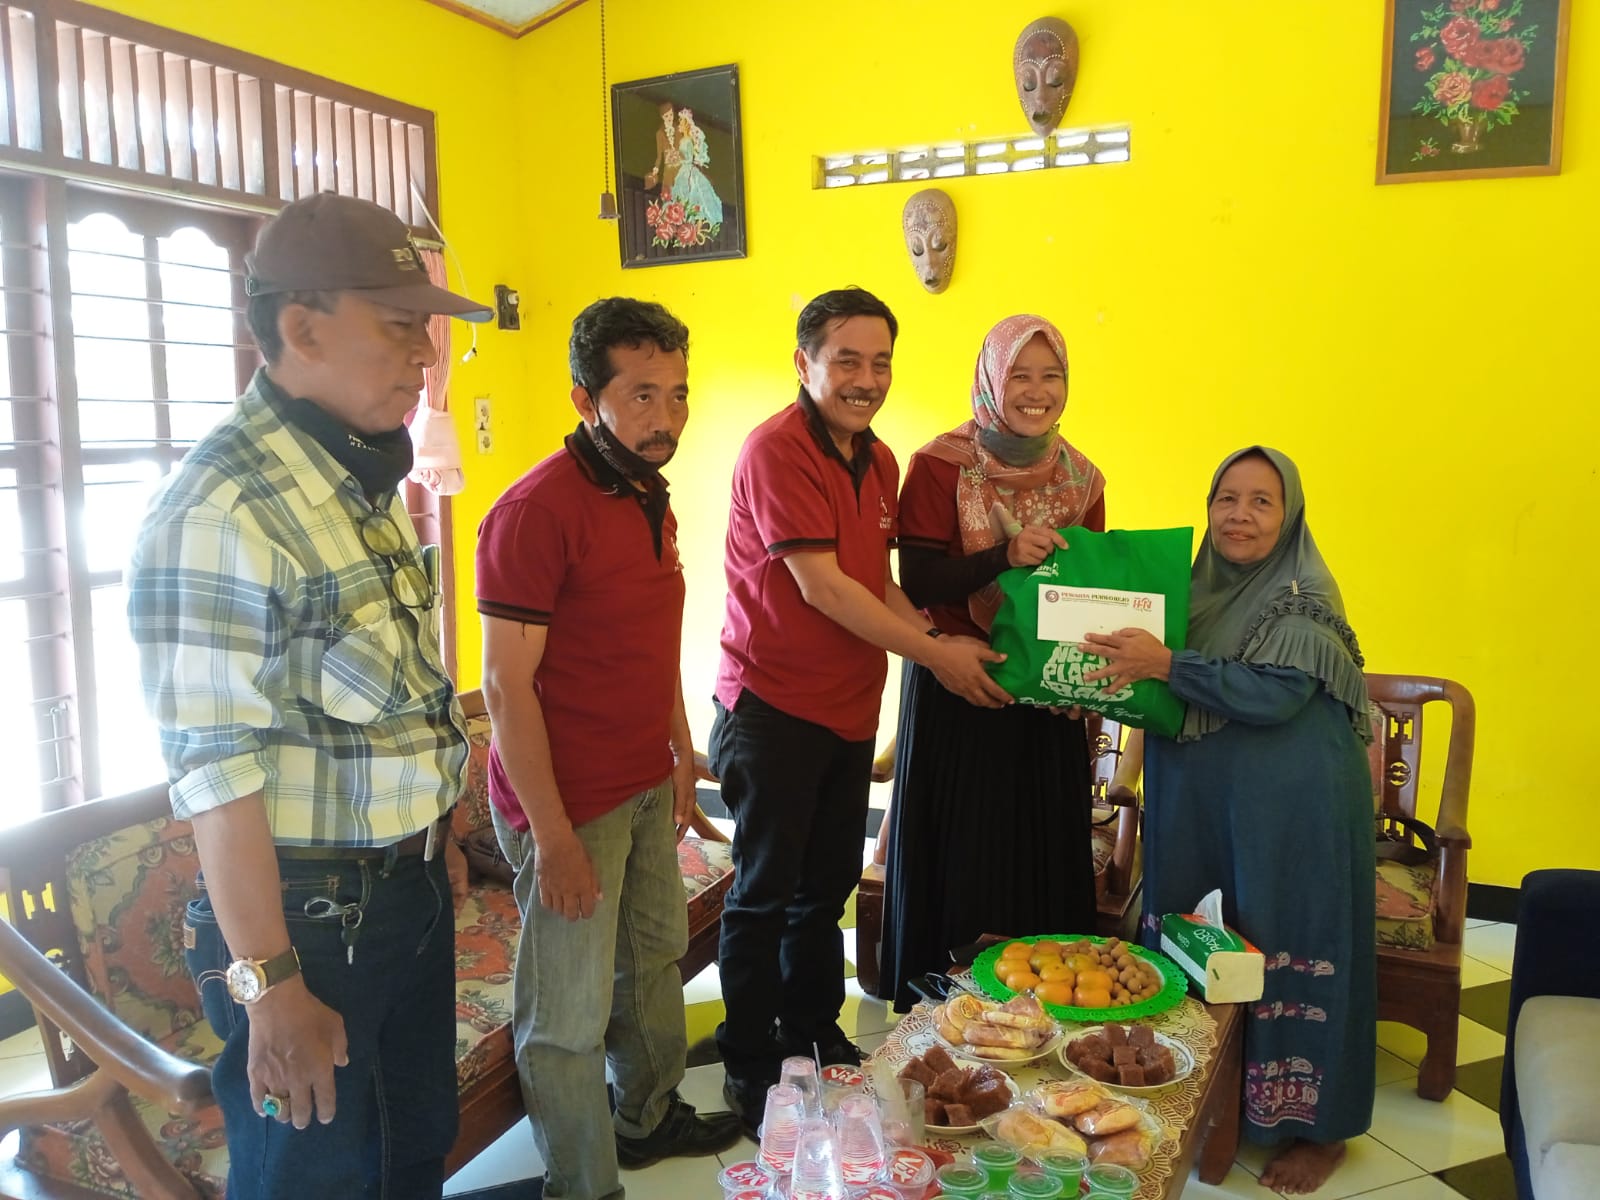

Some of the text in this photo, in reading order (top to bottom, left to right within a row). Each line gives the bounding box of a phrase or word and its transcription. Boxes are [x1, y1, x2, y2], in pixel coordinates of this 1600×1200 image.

[1047, 646, 1084, 662] NO
[1042, 663, 1120, 687] PLAST
[1193, 929, 1224, 951] PASEO
